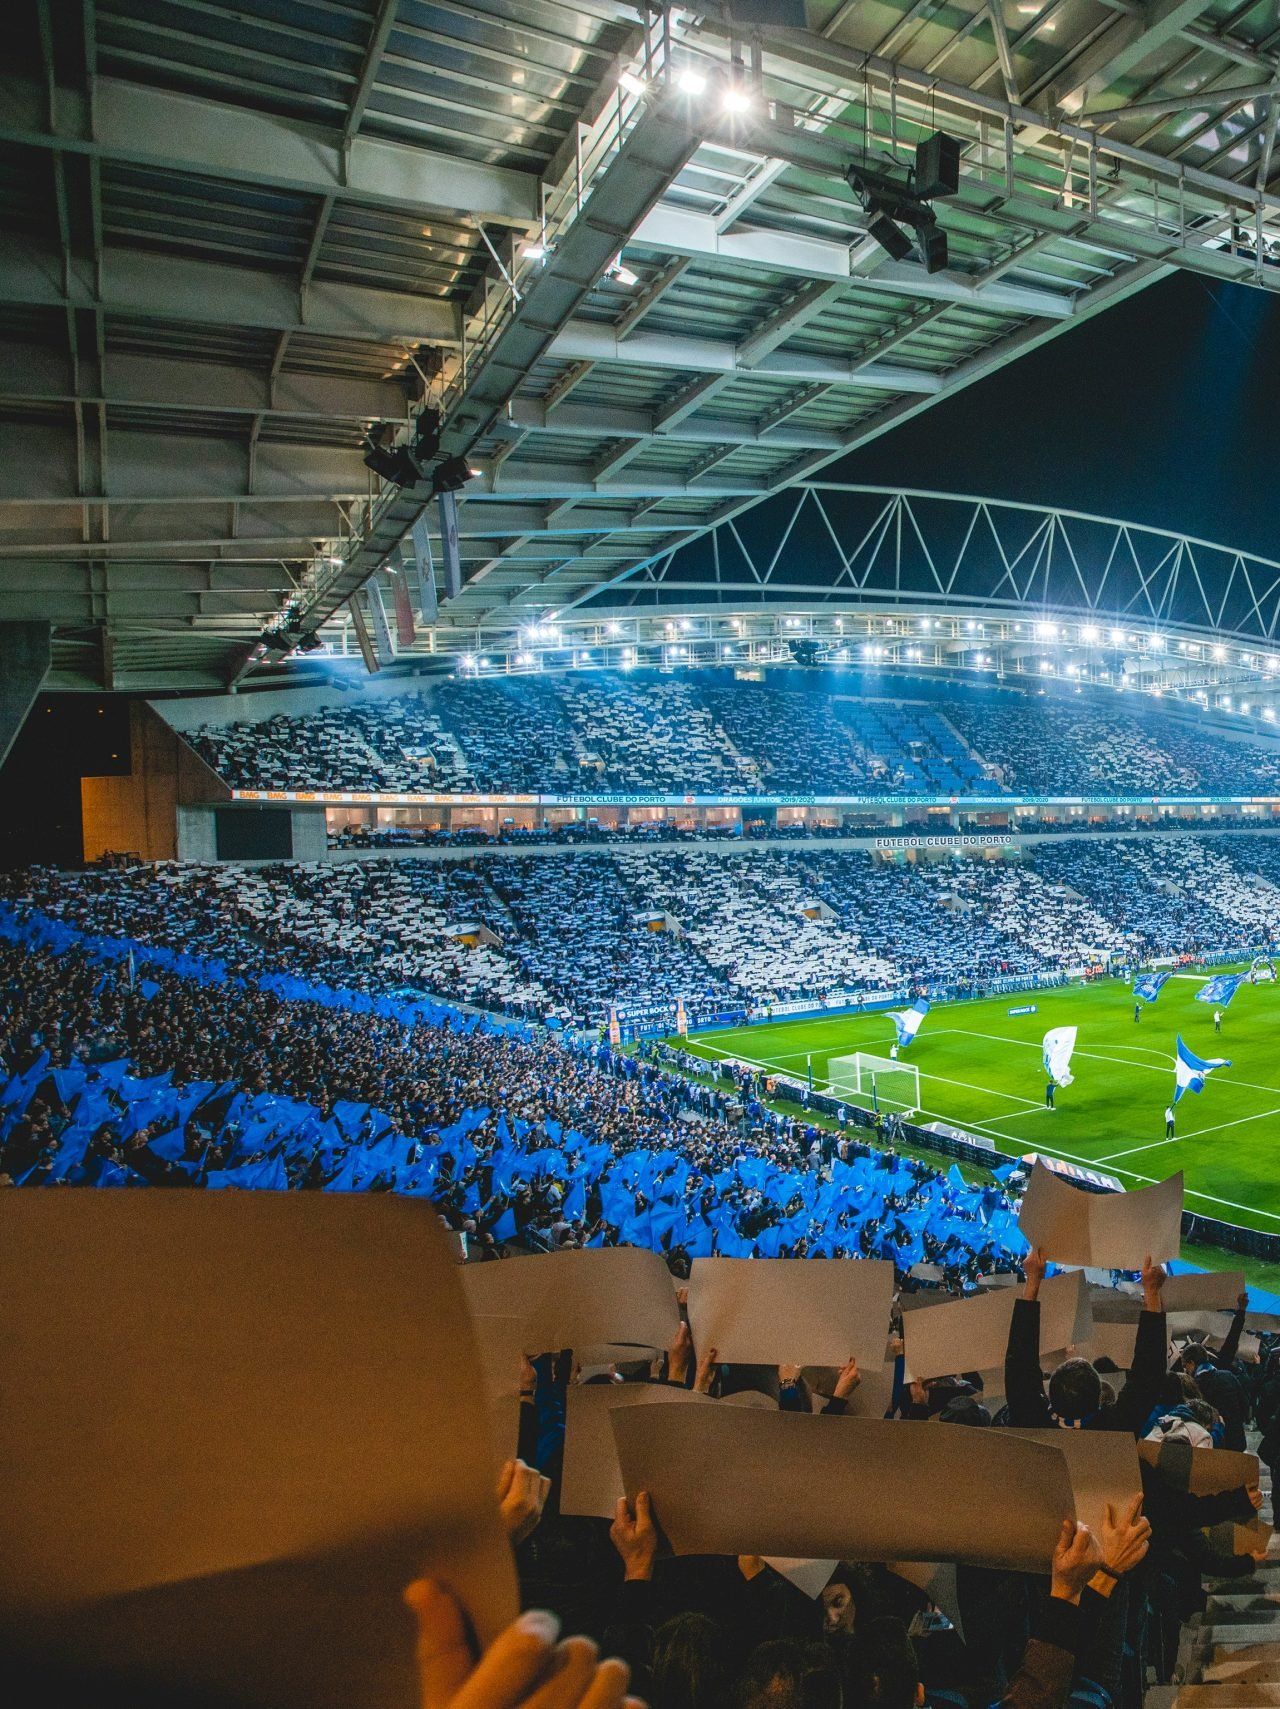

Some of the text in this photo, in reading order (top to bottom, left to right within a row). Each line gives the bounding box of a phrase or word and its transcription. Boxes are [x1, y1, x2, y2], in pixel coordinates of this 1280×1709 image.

[876, 835, 1012, 848] FUTEBOL CLUBE DO PORTO
[626, 1006, 669, 1018] SUPER BOCK
[772, 1005, 792, 1014] UTEBOL
